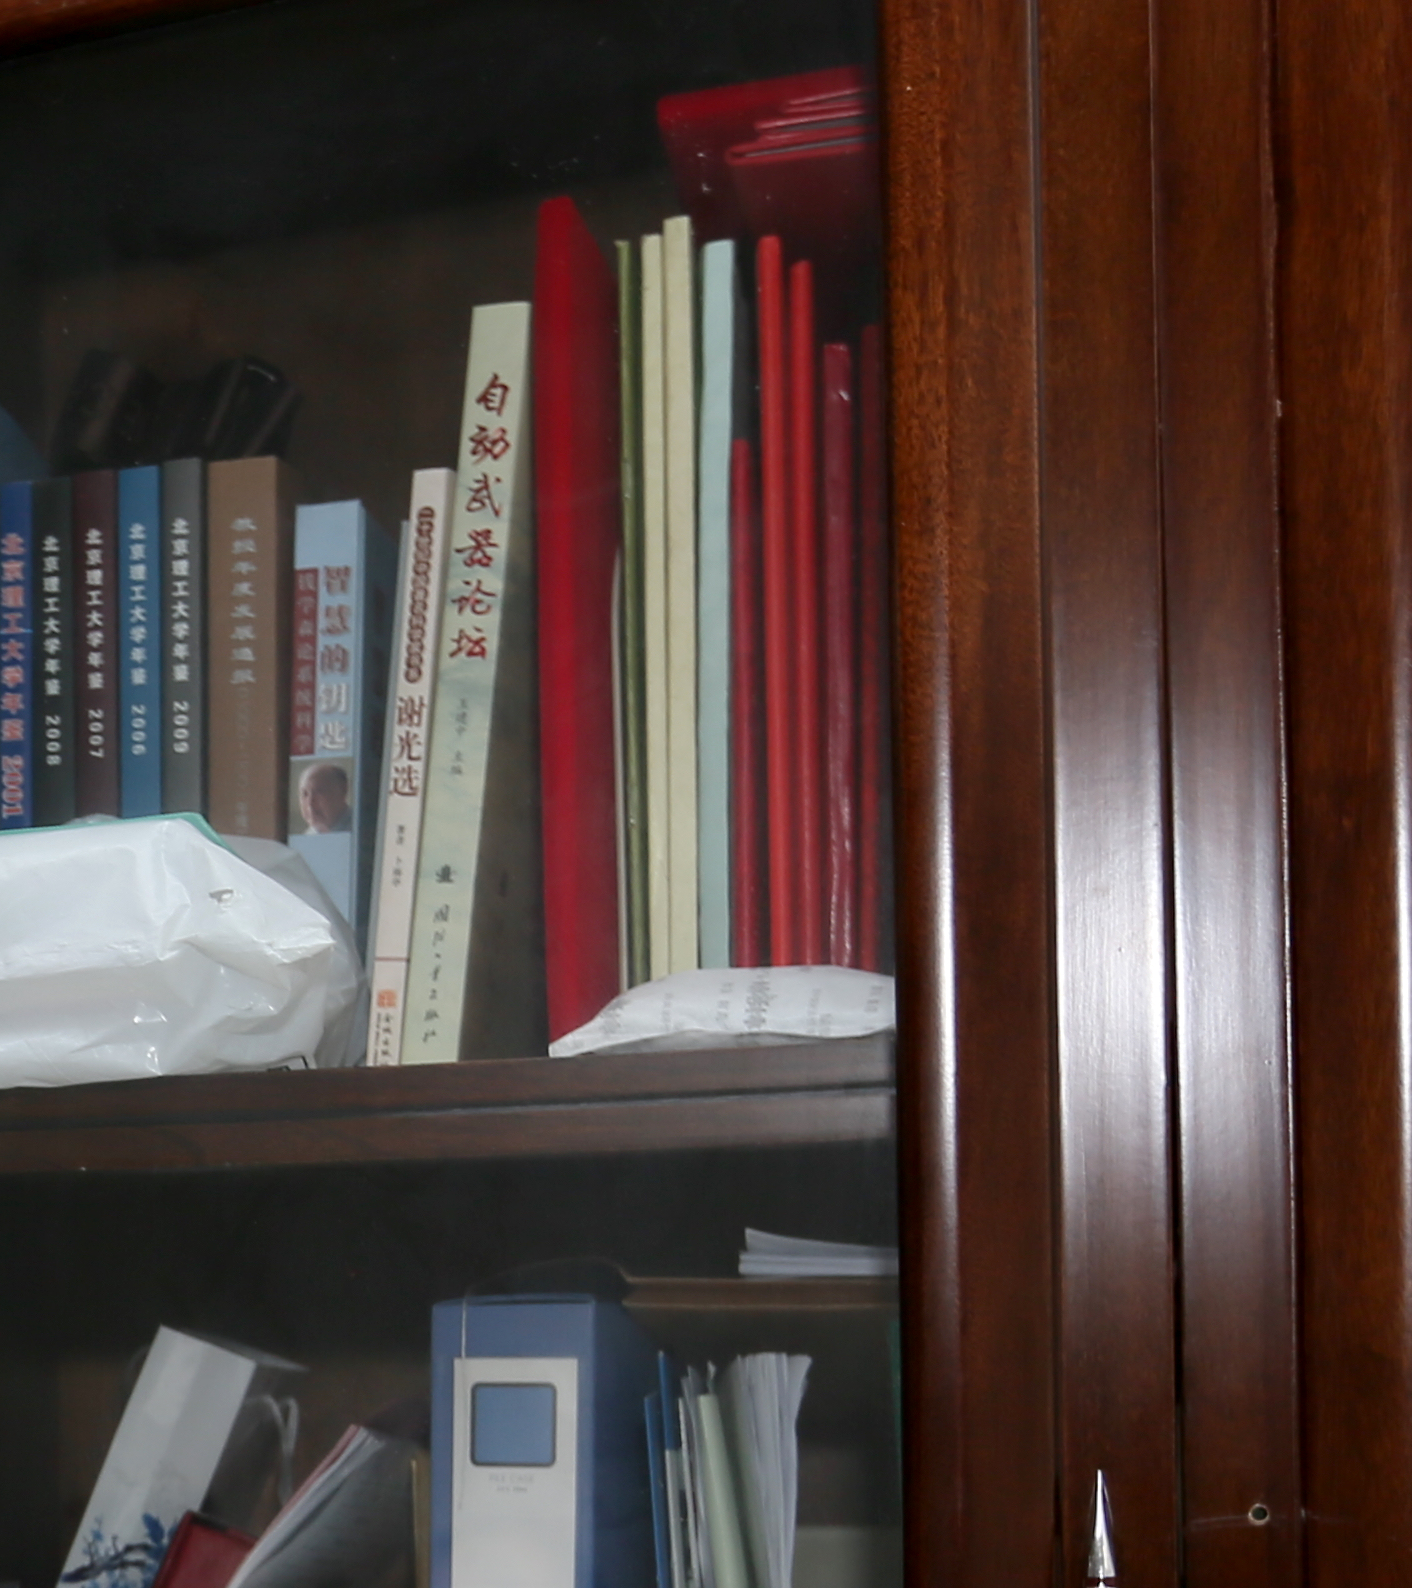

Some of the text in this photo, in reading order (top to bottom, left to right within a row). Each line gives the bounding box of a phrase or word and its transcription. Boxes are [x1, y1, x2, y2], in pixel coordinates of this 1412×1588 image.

[448, 373, 511, 660] 自动武器论坛
[319, 565, 353, 750] 智慧的钥匙
[45, 714, 62, 766] 2008
[88, 707, 105, 759] 2007
[131, 703, 147, 756] 2006
[173, 700, 190, 754] 2009
[389, 695, 426, 796] 谢光选
[1, 754, 23, 819] 2001
